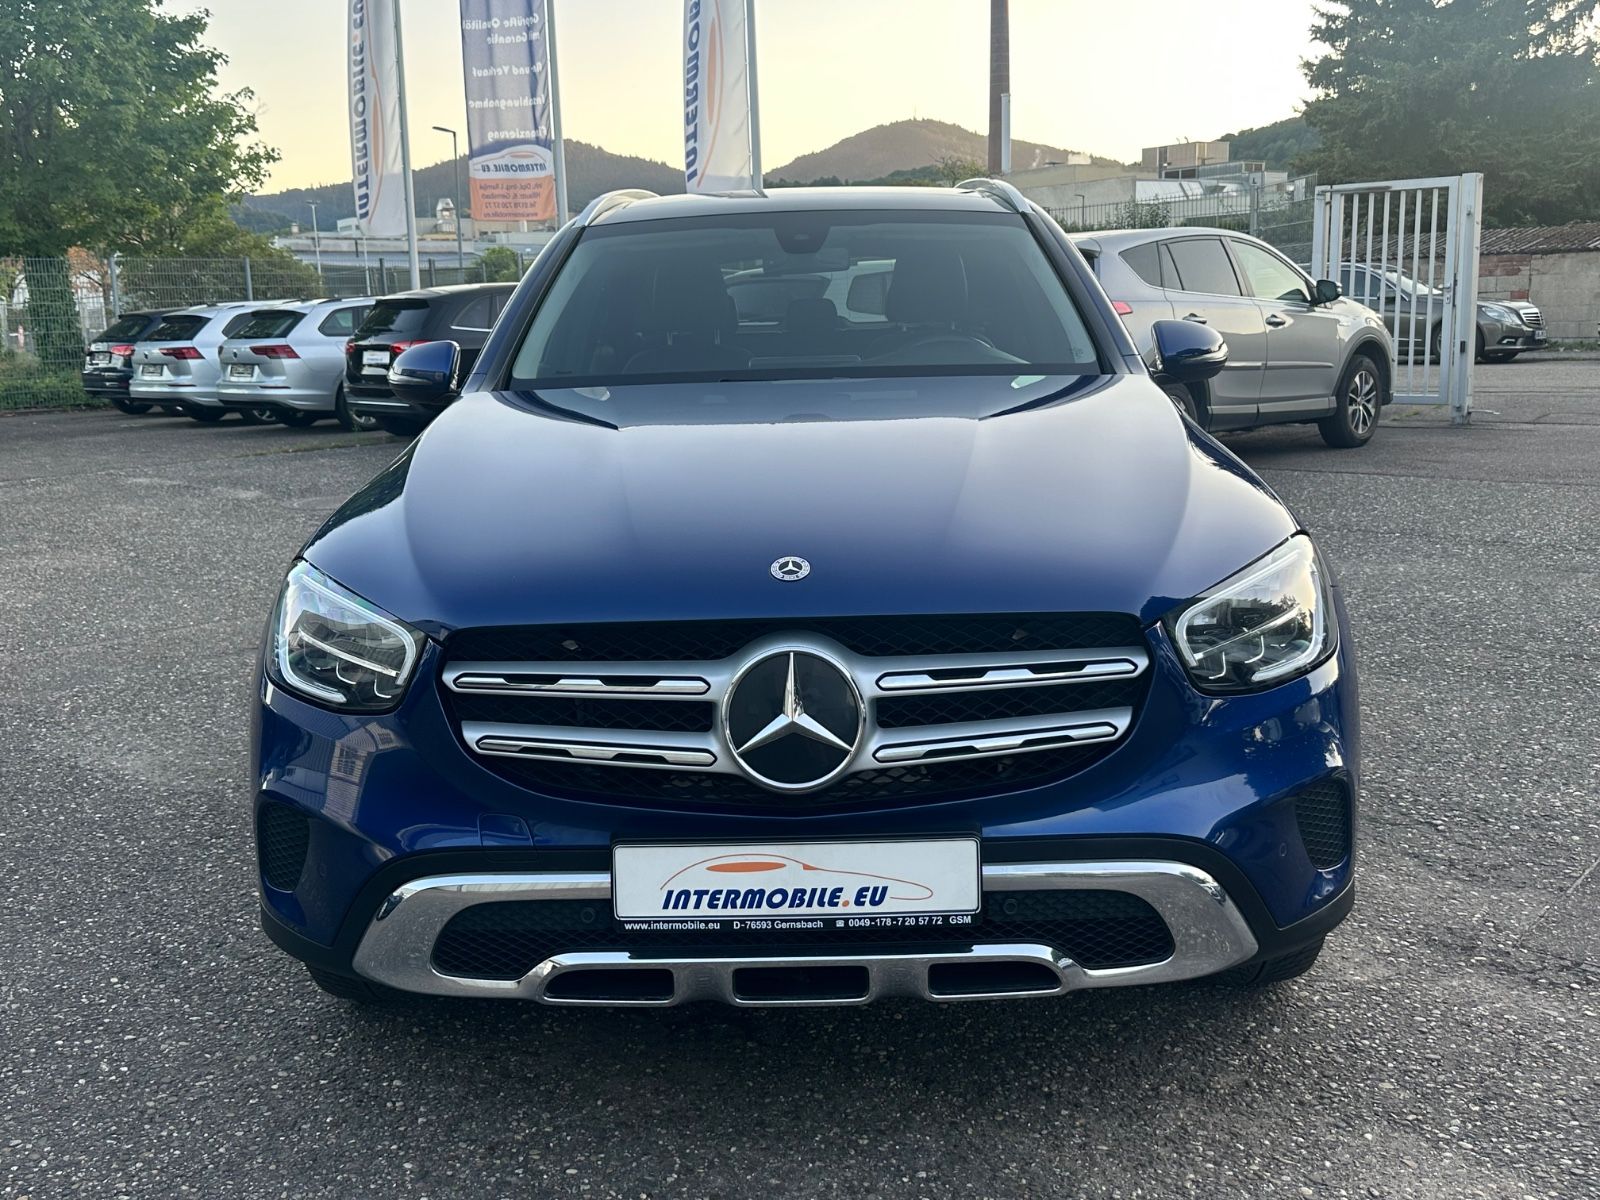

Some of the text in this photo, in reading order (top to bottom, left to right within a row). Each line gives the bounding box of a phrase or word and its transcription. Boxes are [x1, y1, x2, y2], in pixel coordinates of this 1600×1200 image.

[661, 886, 889, 911] INTERMOBILE.EU
[624, 920, 721, 930] www.intermobile.eu
[733, 920, 772, 930] D-76593
[774, 919, 824, 930] Gernsbach
[949, 915, 972, 924] GSM
